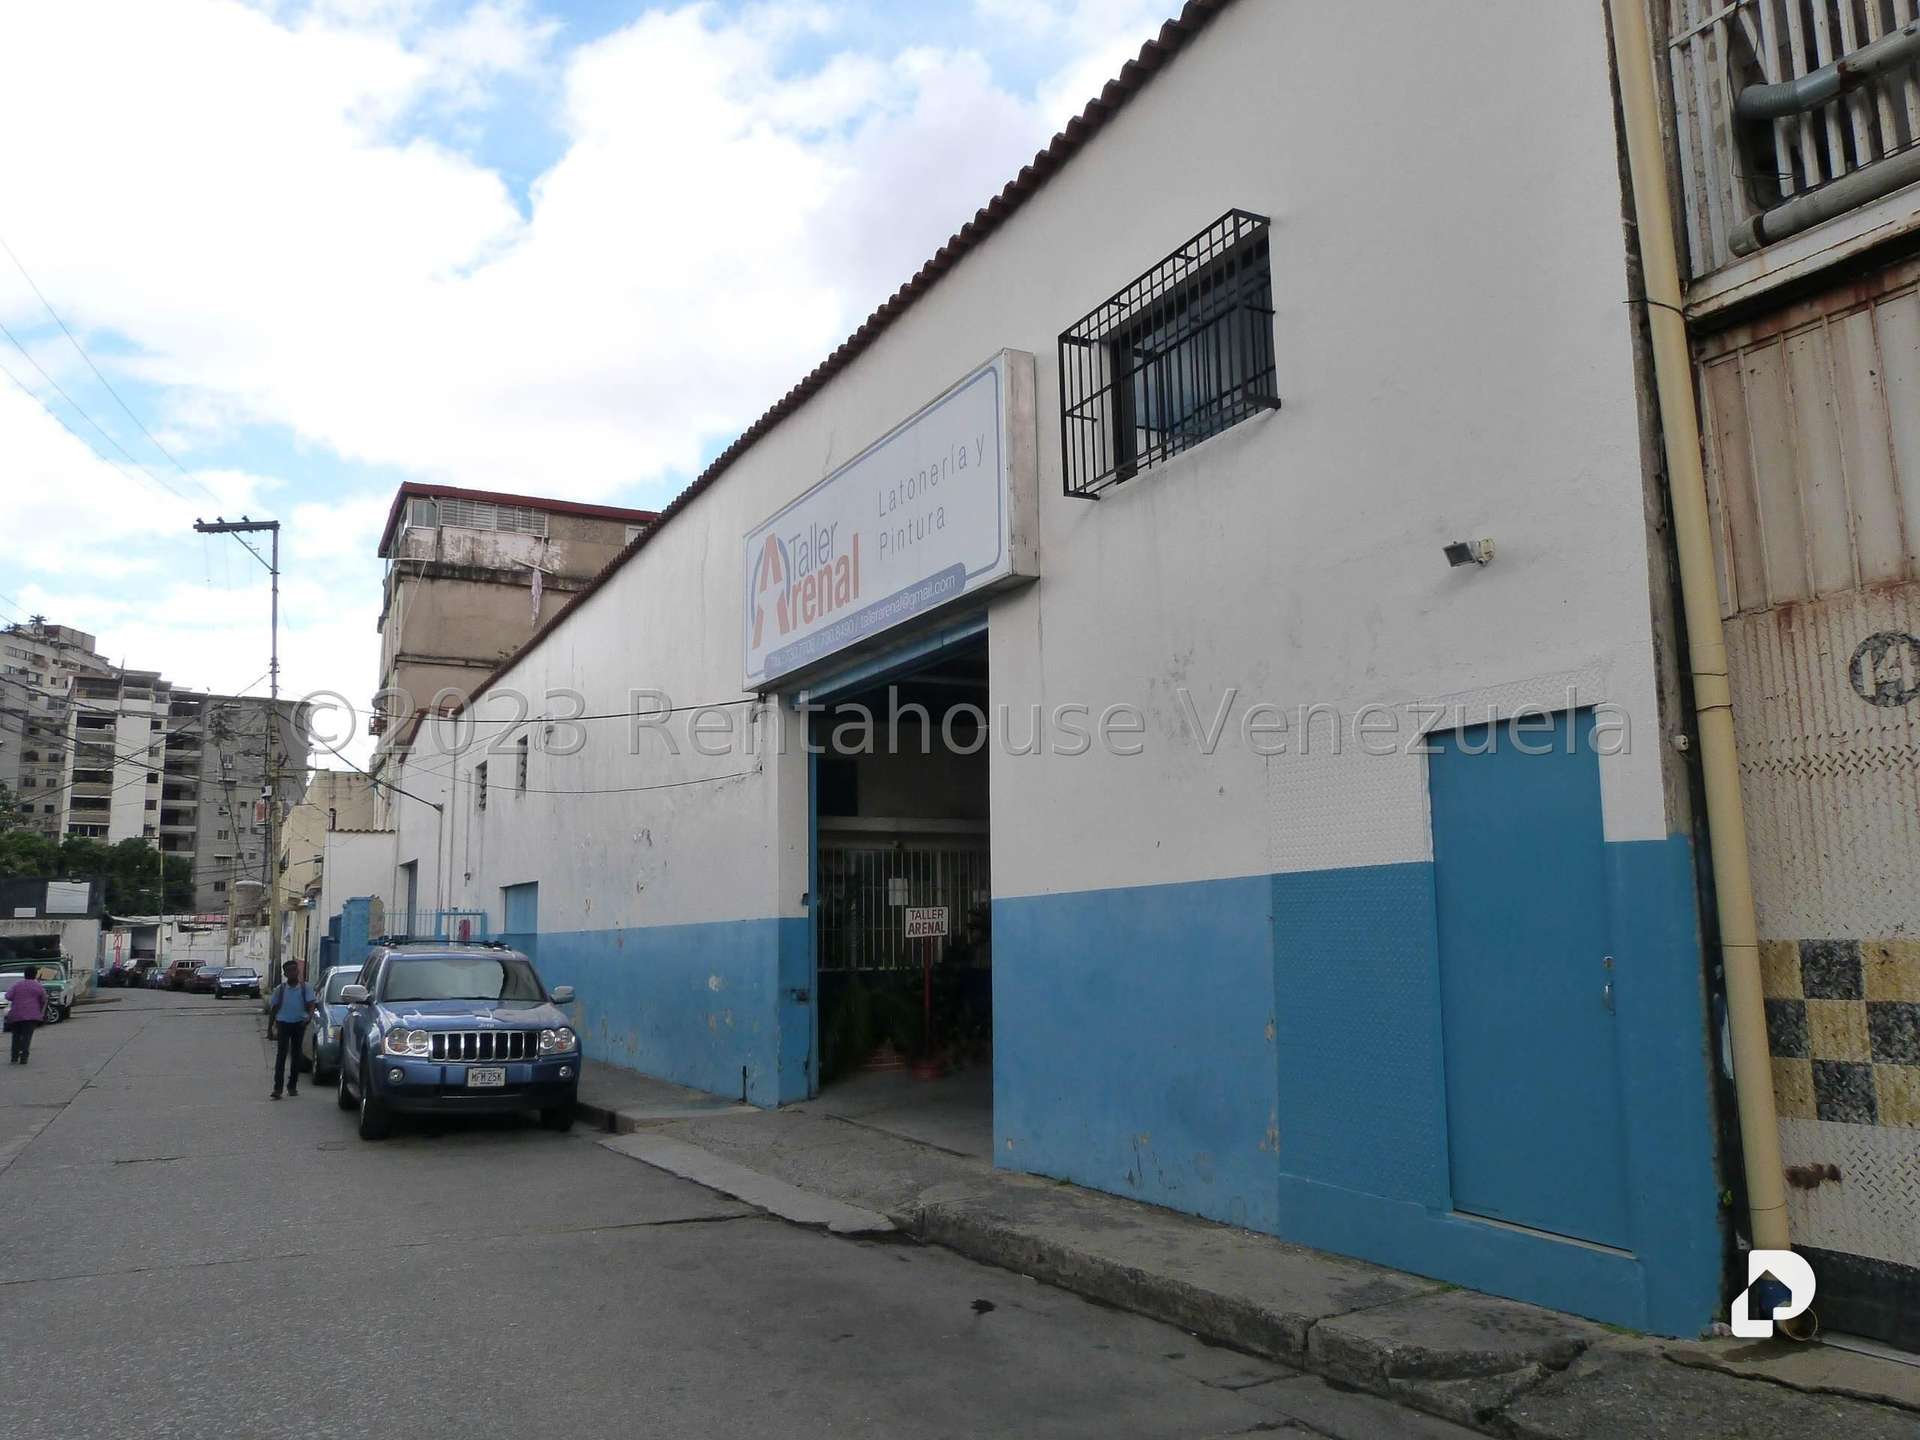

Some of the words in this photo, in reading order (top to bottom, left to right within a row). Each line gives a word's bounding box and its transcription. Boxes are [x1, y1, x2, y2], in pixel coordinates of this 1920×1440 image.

[976, 433, 985, 467] y
[880, 506, 945, 561] Pintura
[788, 520, 838, 582] Taller
[908, 921, 946, 935] ARENAL
[910, 909, 944, 920] TALLER
